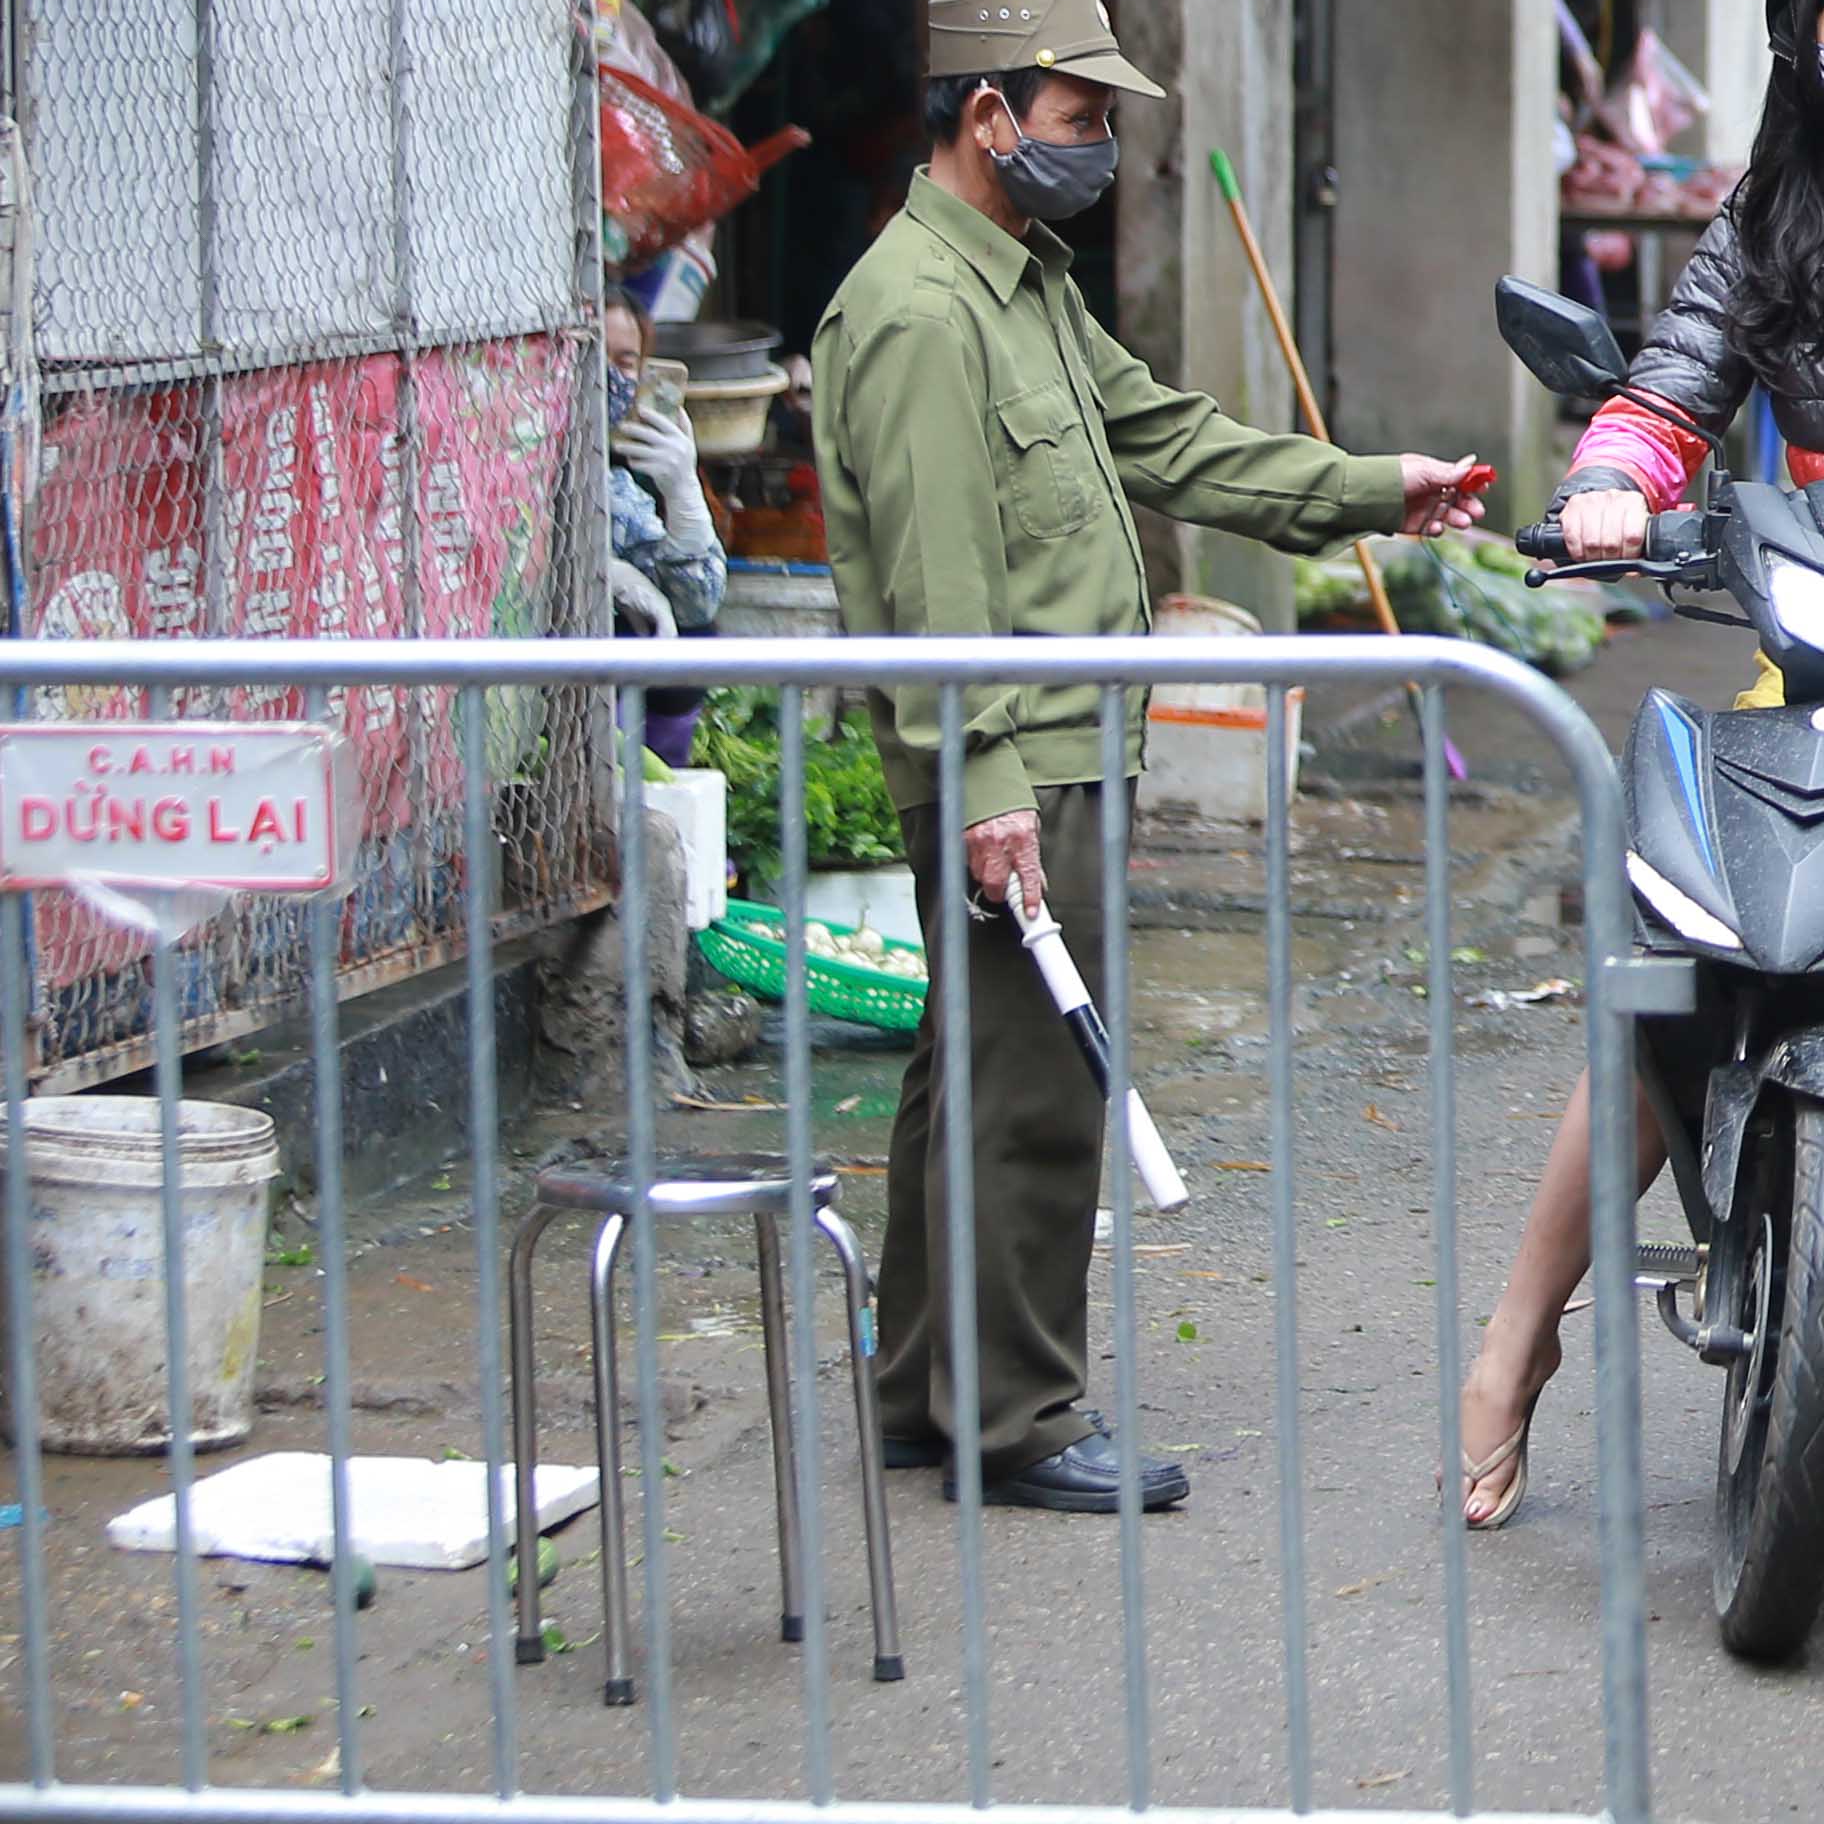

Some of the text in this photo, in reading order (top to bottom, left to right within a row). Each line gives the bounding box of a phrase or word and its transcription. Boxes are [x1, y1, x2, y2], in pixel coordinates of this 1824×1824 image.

[88, 744, 237, 775] C.A.H.N
[20, 778, 307, 855] DỪNG LẠI
